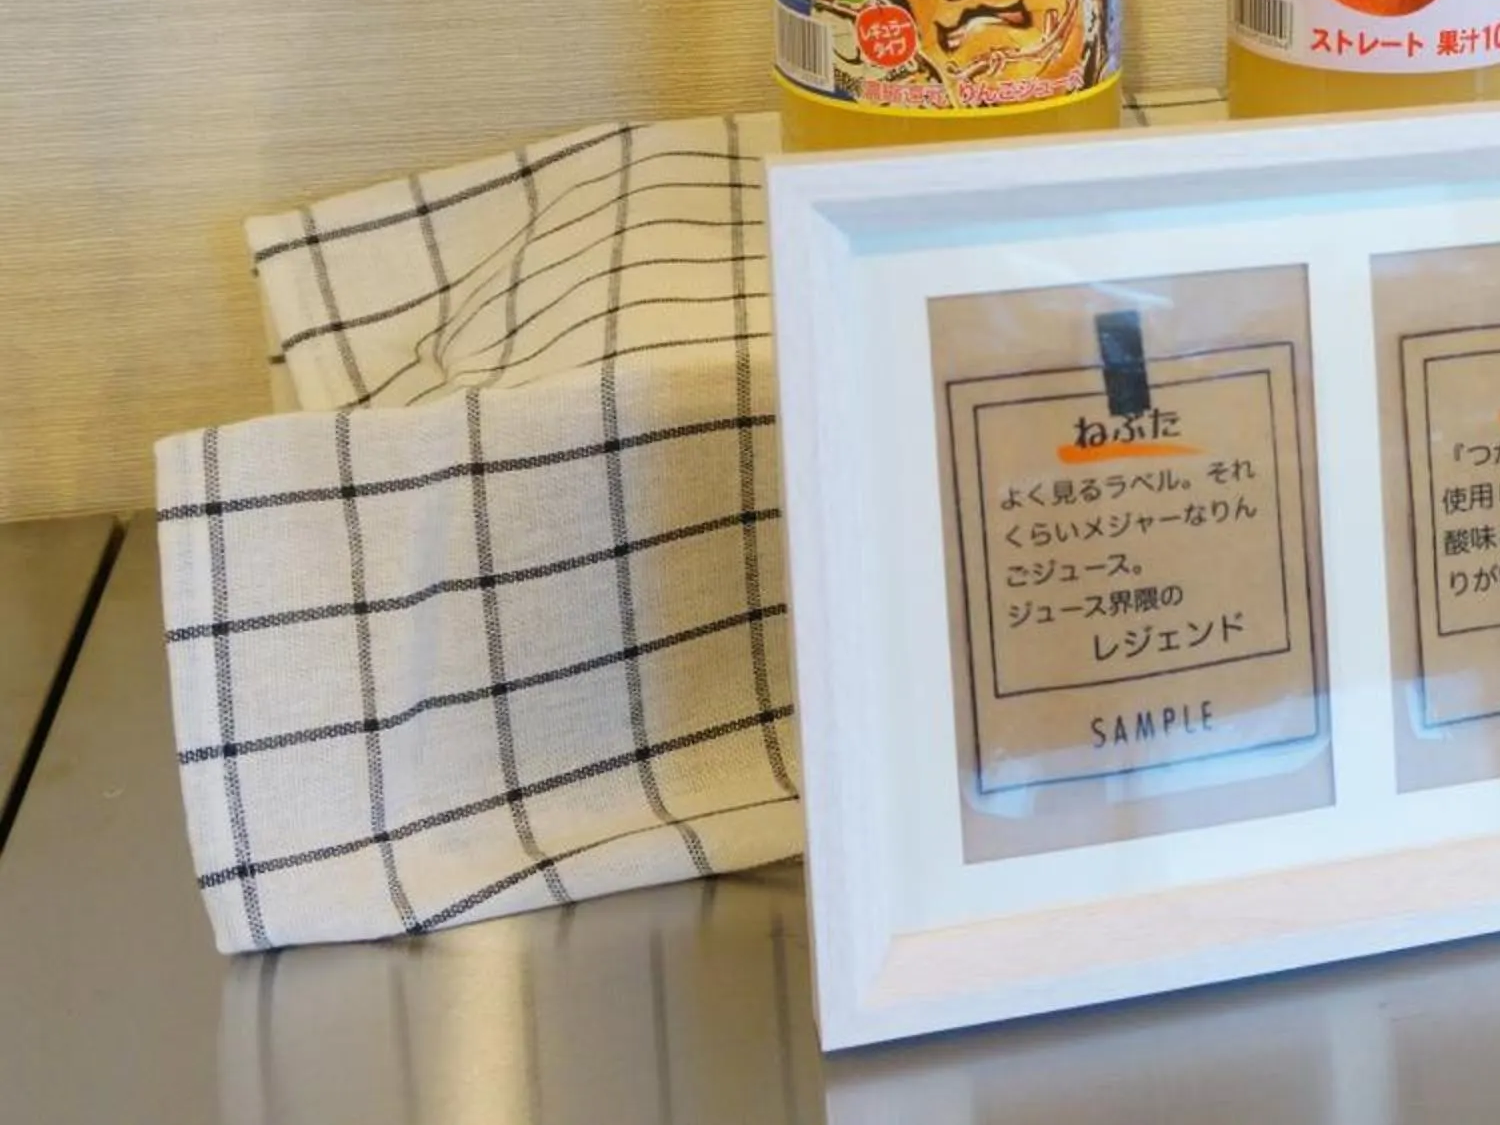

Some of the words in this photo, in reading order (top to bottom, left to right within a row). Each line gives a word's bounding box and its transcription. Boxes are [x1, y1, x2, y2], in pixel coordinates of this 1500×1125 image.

[1310, 27, 1424, 58] ストレート
[1074, 407, 1182, 449] ねぶた
[1004, 496, 1258, 548] くらいメジャーなりん
[1005, 553, 1144, 590] ごジュース。
[1008, 583, 1184, 629] ジュース界隈の
[1092, 611, 1245, 663] レジェンド
[1091, 699, 1214, 750] SAMPLE
